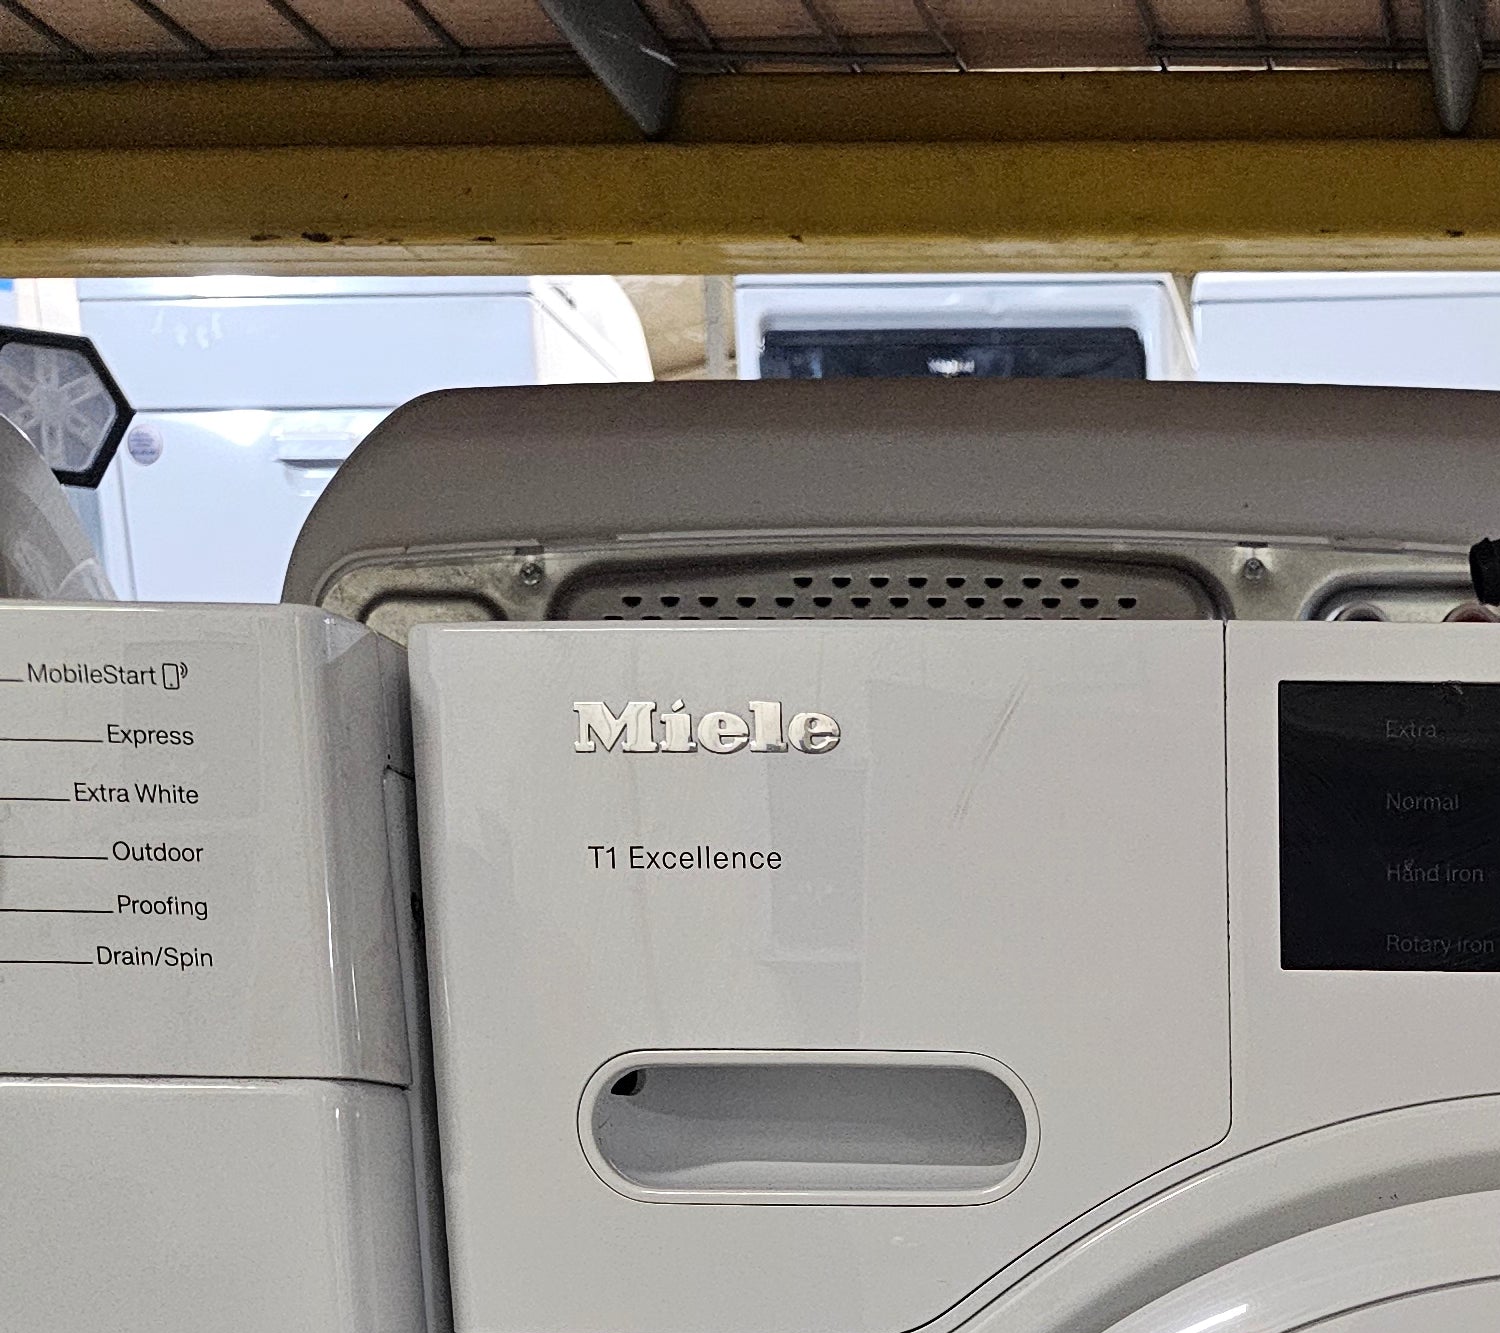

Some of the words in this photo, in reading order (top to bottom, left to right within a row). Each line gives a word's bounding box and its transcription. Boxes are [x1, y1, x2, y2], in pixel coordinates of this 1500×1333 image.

[27, 662, 157, 686] MobileStart
[107, 724, 194, 749] Express
[572, 699, 841, 754] Miele
[1385, 720, 1437, 739] Extra
[73, 781, 131, 803] Extra
[134, 783, 199, 805] White
[1385, 793, 1460, 811] Normal
[112, 840, 204, 863] Outdoor
[587, 845, 616, 870] T1
[629, 845, 782, 870] Excellence
[1385, 864, 1440, 883] Hand
[1445, 863, 1484, 883] iron
[117, 894, 208, 920] Proofing
[1385, 934, 1451, 957] Rotary
[1457, 935, 1495, 954] iron
[96, 945, 213, 972] Drain/Spin
